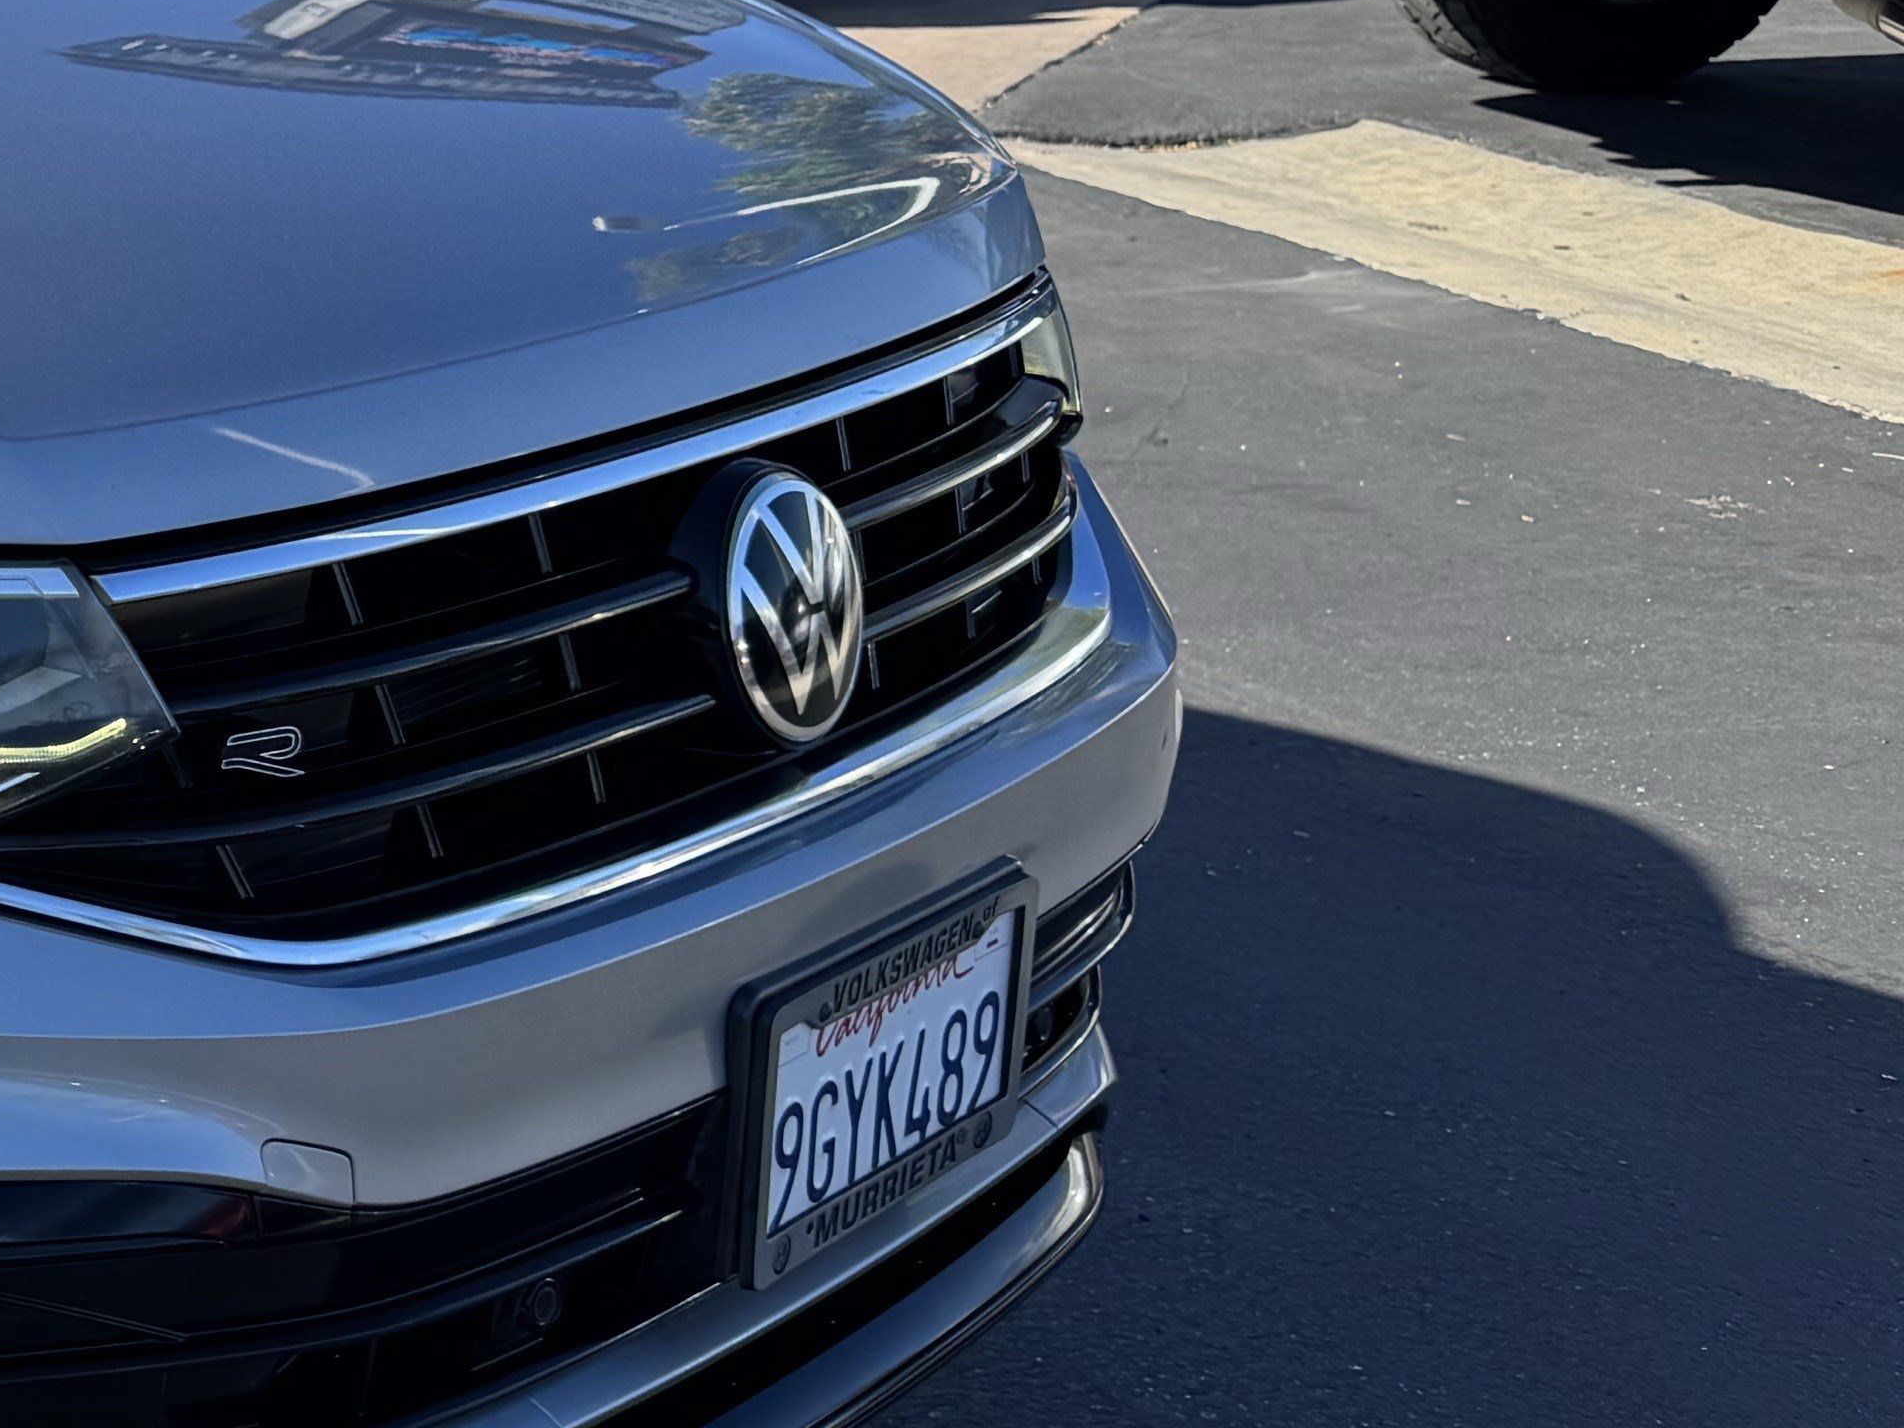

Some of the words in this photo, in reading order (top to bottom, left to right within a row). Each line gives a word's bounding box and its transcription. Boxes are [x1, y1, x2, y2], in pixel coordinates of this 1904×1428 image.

[220, 725, 305, 777] R
[832, 911, 977, 1013] VOLKSWAGEN
[766, 989, 1000, 1239] 9GYK489
[813, 1133, 956, 1248] MURRIETA
